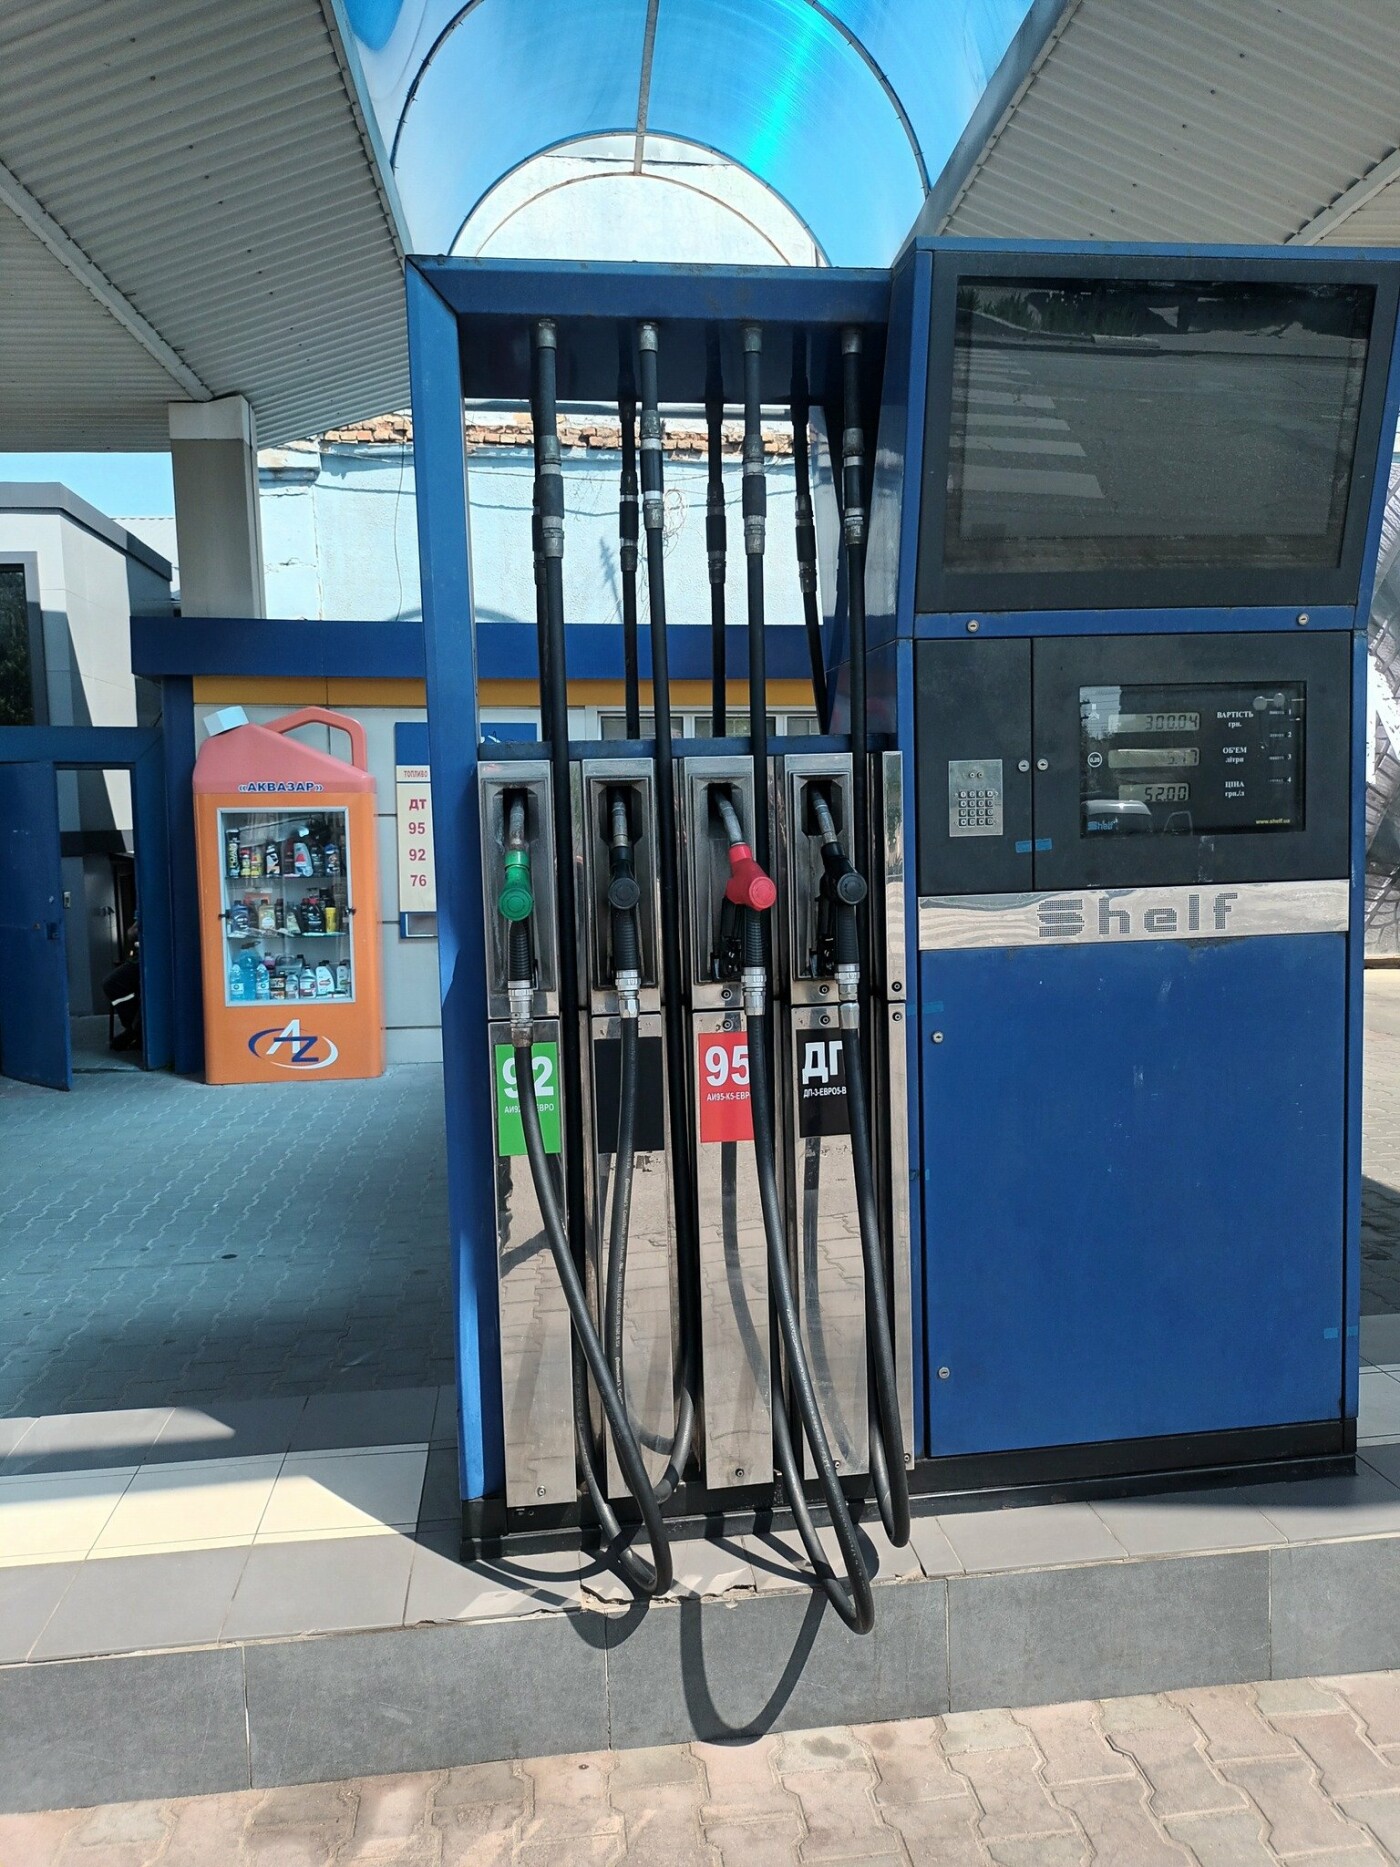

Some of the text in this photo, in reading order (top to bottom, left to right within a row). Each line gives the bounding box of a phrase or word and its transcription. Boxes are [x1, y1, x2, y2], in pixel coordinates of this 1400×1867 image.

[409, 799, 427, 810] ДТ
[408, 822, 426, 835] 95
[409, 848, 427, 861] 92
[410, 875, 427, 887] 76
[1037, 892, 1238, 938] Shelf
[705, 1045, 750, 1087] 95
[502, 1055, 554, 1099] 92
